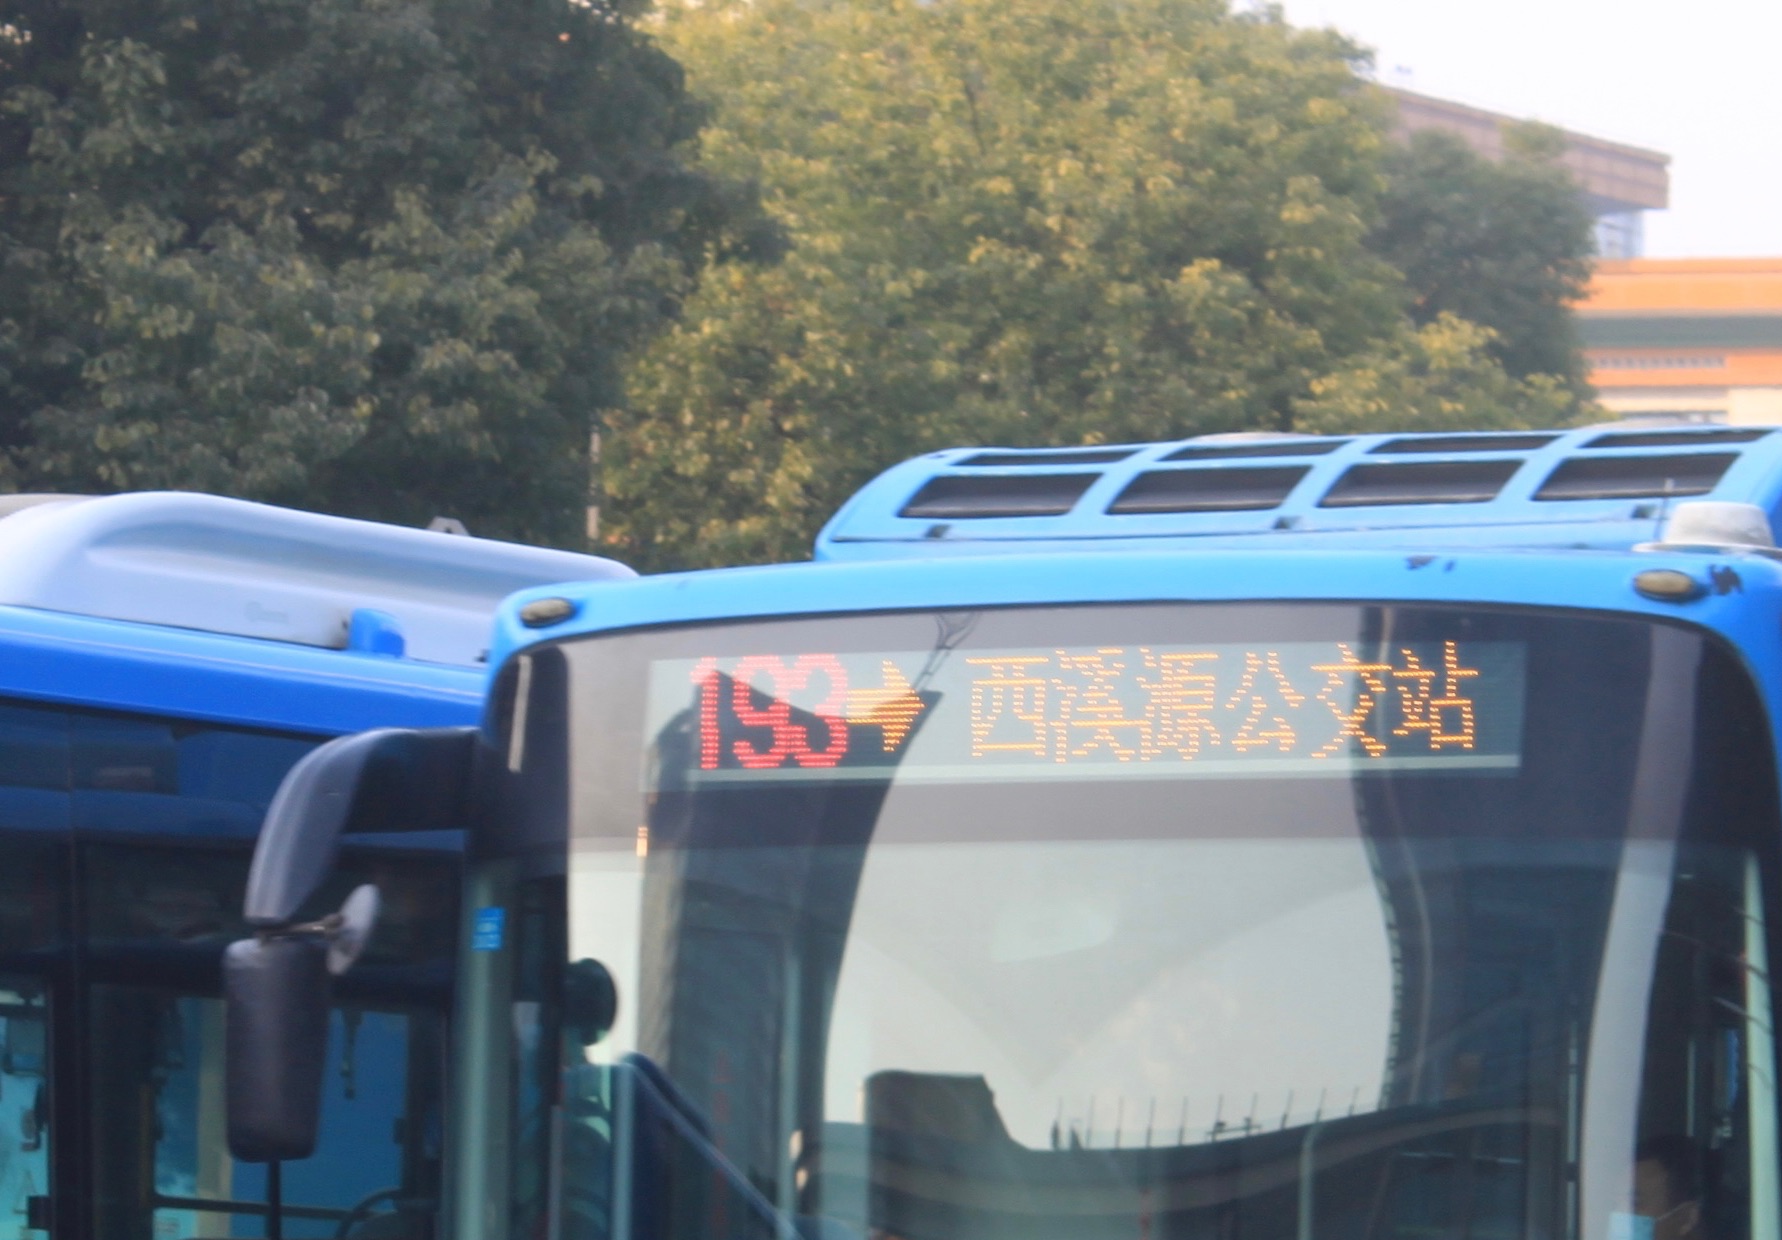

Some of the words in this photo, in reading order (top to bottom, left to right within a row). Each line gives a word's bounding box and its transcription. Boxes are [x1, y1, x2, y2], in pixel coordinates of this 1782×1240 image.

[690, 655, 848, 769] 193
[966, 640, 1480, 762] 西溪源公交站
